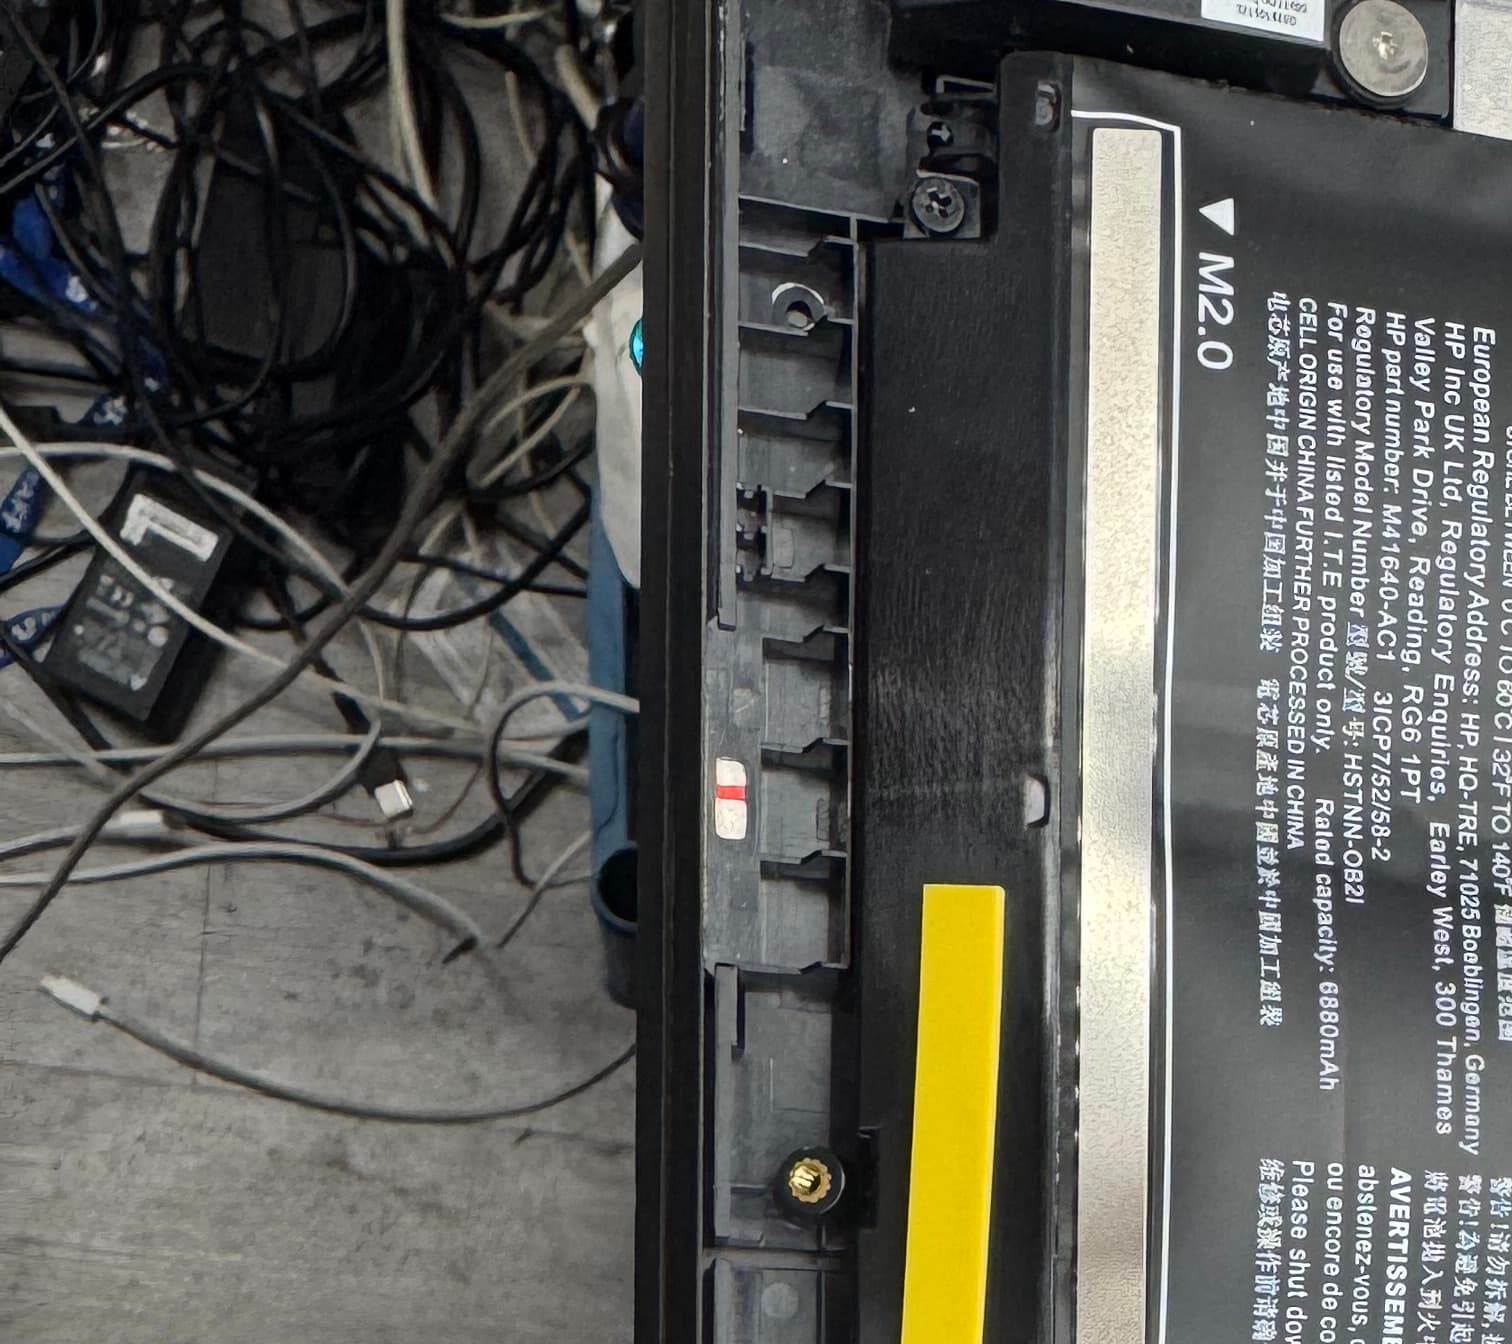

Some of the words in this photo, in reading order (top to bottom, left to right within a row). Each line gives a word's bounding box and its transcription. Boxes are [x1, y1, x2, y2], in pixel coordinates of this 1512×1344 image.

[1197, 252, 1234, 369] M2.0
[1328, 302, 1348, 342] For
[1385, 312, 1406, 347] HP
[1328, 349, 1343, 390] use
[1351, 307, 1376, 435] Regulatory
[1381, 348, 1403, 395] part
[1409, 318, 1436, 392] Valley
[1469, 327, 1496, 443] European
[1327, 400, 1346, 446] with
[1384, 399, 1404, 494] number:
[1413, 400, 1435, 458] Park
[1325, 456, 1346, 522] listed
[1353, 440, 1375, 513] Model
[1408, 469, 1433, 543] Drive,
[1463, 450, 1493, 588] Regulatory
[1323, 531, 1344, 587] I.T.E
[1348, 519, 1372, 618] Number
[1376, 504, 1402, 660] M41640-AC1
[1316, 596, 1338, 690] product
[1400, 556, 1430, 672] Reading,
[1461, 590, 1488, 705] Address:
[1310, 699, 1335, 753] only.
[1401, 685, 1424, 742] RG6
[1457, 713, 1480, 749] HP,
[1371, 691, 1393, 861] 3ICP7/52/58-2
[1400, 754, 1421, 804] 1PT
[1456, 756, 1478, 851] HQ-TRE,
[1315, 799, 1335, 865] Rated
[1491, 801, 1511, 834] TO
[1312, 874, 1338, 973] capacity:
[1459, 859, 1480, 920] 71025
[1460, 925, 1483, 1047] Boeblingen,
[1319, 982, 1339, 1090] 6880mAh
[1459, 1055, 1485, 1155] Germany
[1291, 1161, 1314, 1239] Please
[1287, 1248, 1311, 1297] shut
